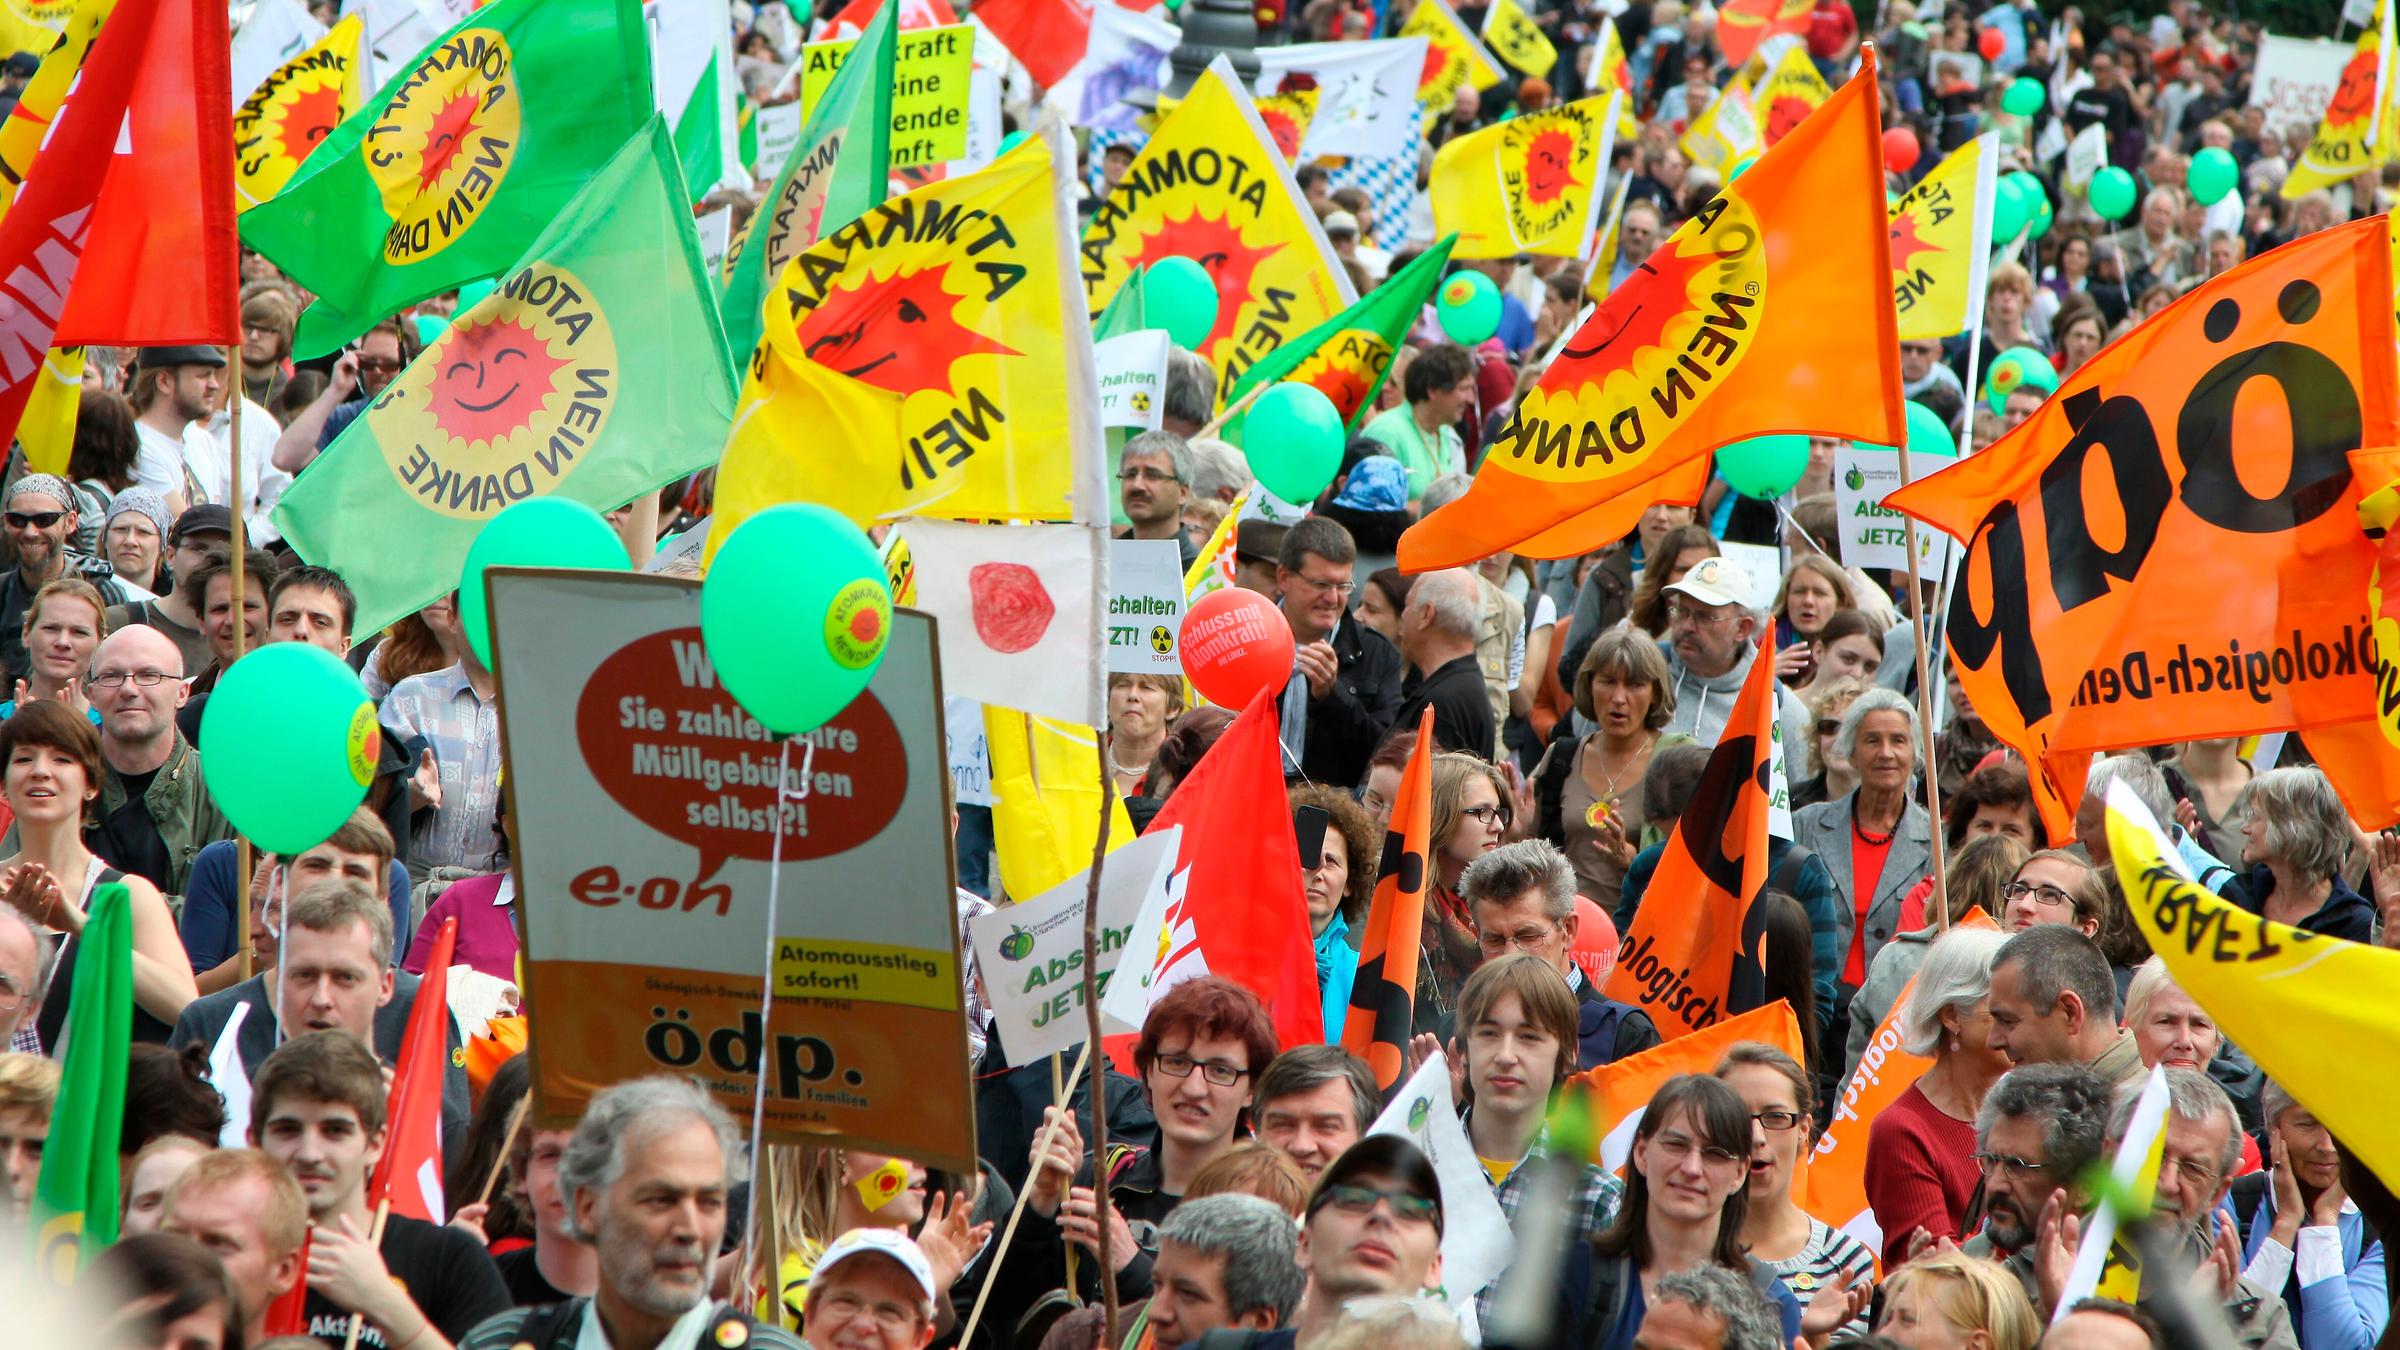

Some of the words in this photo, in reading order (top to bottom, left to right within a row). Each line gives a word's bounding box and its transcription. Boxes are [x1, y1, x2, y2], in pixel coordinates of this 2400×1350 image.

[1181, 611, 1235, 656] Schluss
[1188, 619, 1269, 672] Atomkraft!
[619, 696, 666, 731] Sie
[686, 795, 808, 838] selbst?!
[780, 944, 938, 978] Atomausstieg
[783, 969, 860, 990] sofort!
